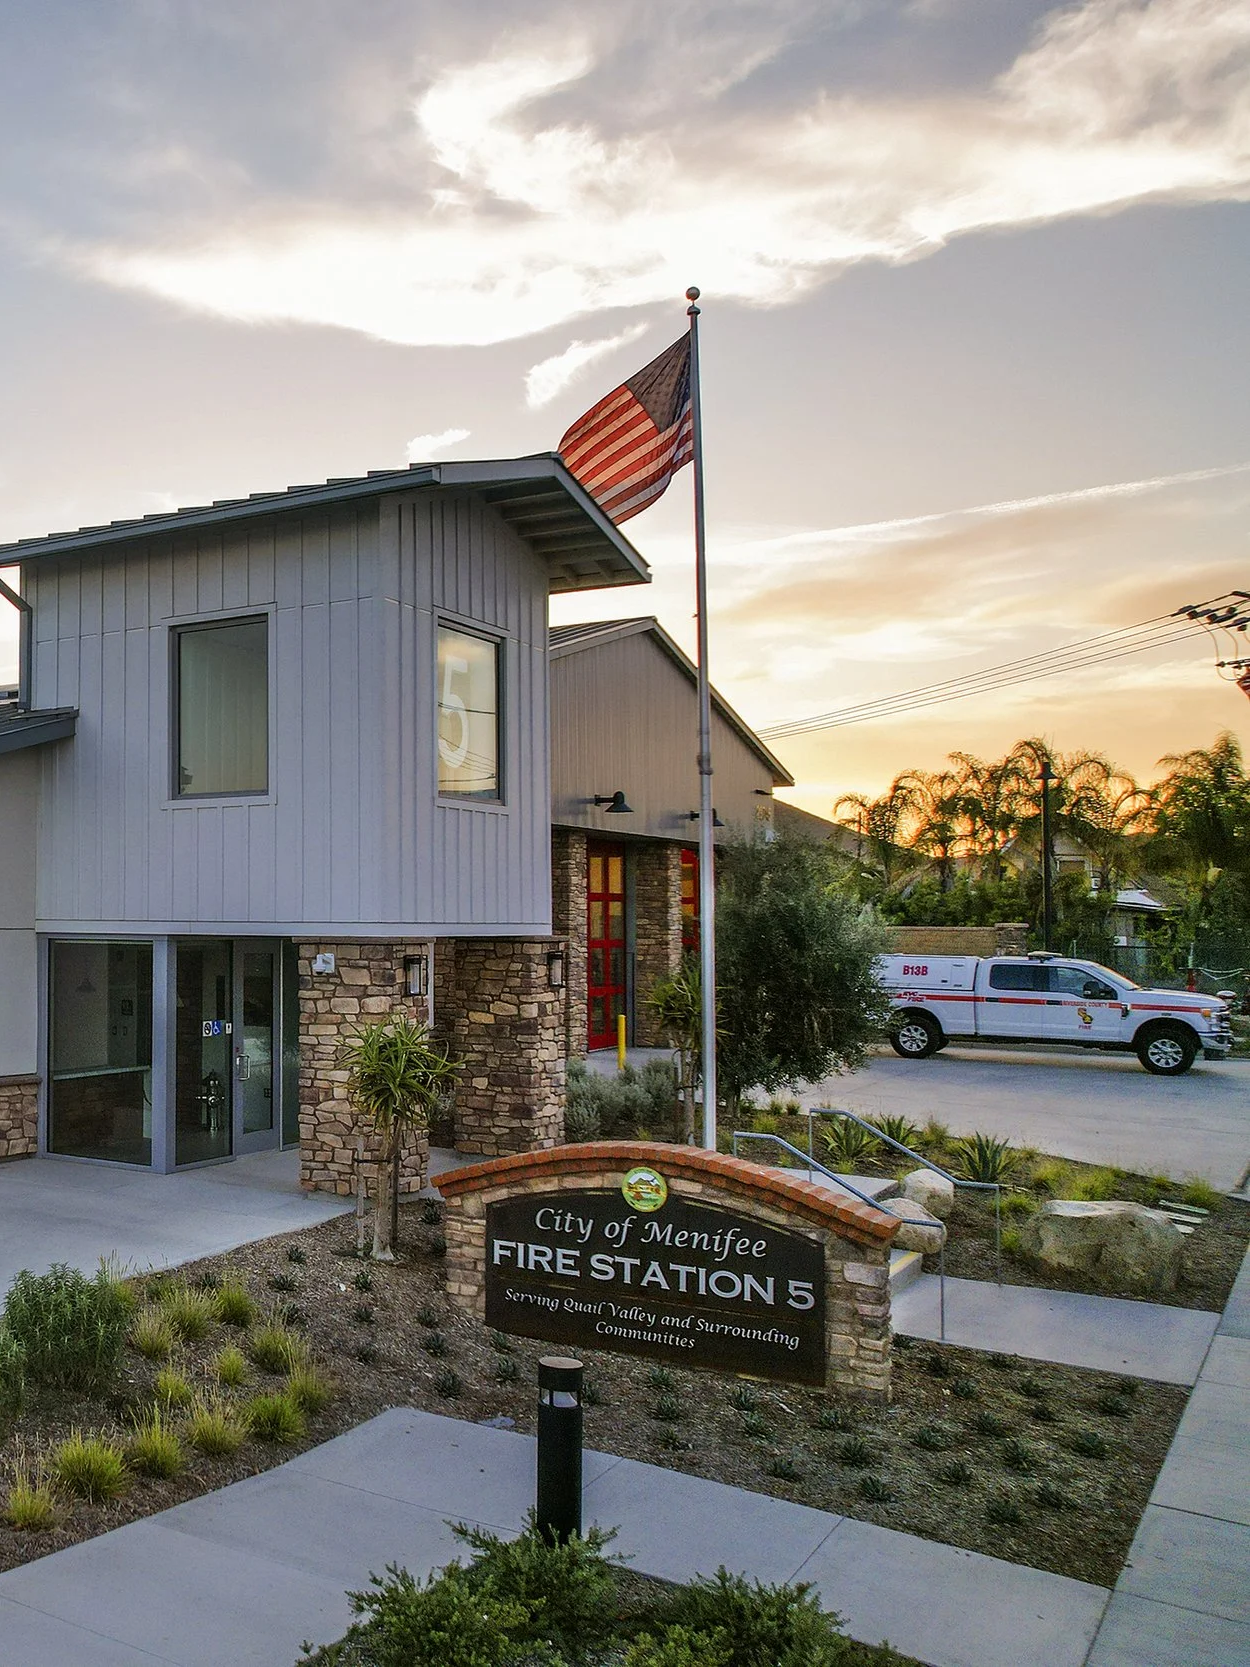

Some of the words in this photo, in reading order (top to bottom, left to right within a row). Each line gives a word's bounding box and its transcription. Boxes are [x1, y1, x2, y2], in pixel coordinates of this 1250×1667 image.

[438, 655, 469, 768] 5
[903, 965, 928, 976] B13B
[535, 1207, 594, 1243] City
[604, 1215, 637, 1248] of
[640, 1221, 767, 1262] Menifee
[492, 1239, 581, 1277] FIRE
[590, 1253, 775, 1305] STATION
[786, 1279, 815, 1310] 5
[505, 1288, 560, 1312] Serving
[563, 1298, 605, 1315] Quail
[607, 1302, 657, 1327] Valley
[661, 1314, 695, 1329] and
[695, 1318, 800, 1350] Surrounding
[595, 1321, 696, 1349] Communities
